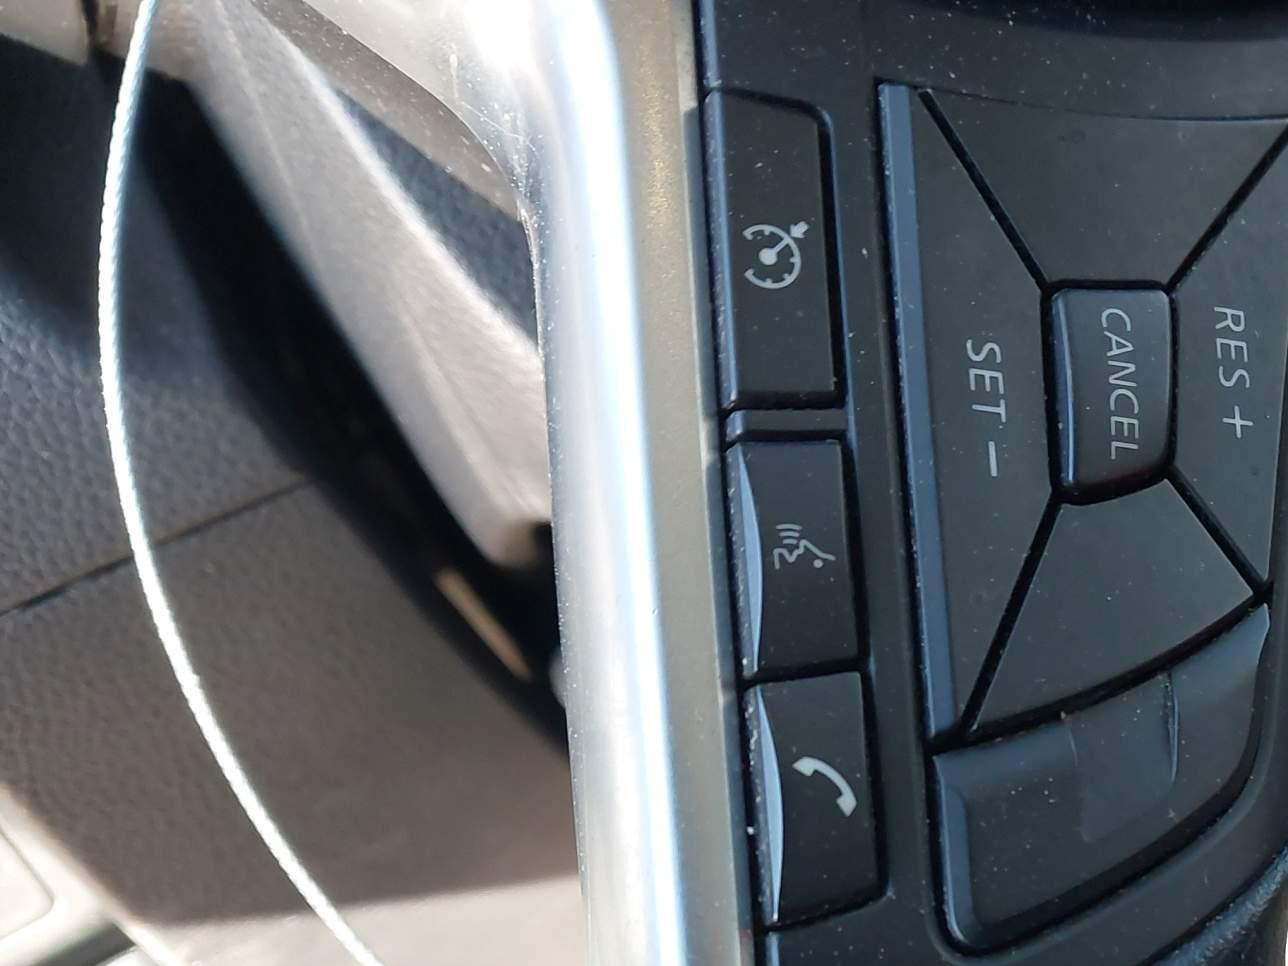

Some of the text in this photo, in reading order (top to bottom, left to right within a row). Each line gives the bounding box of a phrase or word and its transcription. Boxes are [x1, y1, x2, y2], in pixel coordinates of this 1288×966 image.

[966, 338, 1007, 423] SET
[1100, 307, 1139, 460] CANCEL
[1213, 305, 1251, 389] RES
